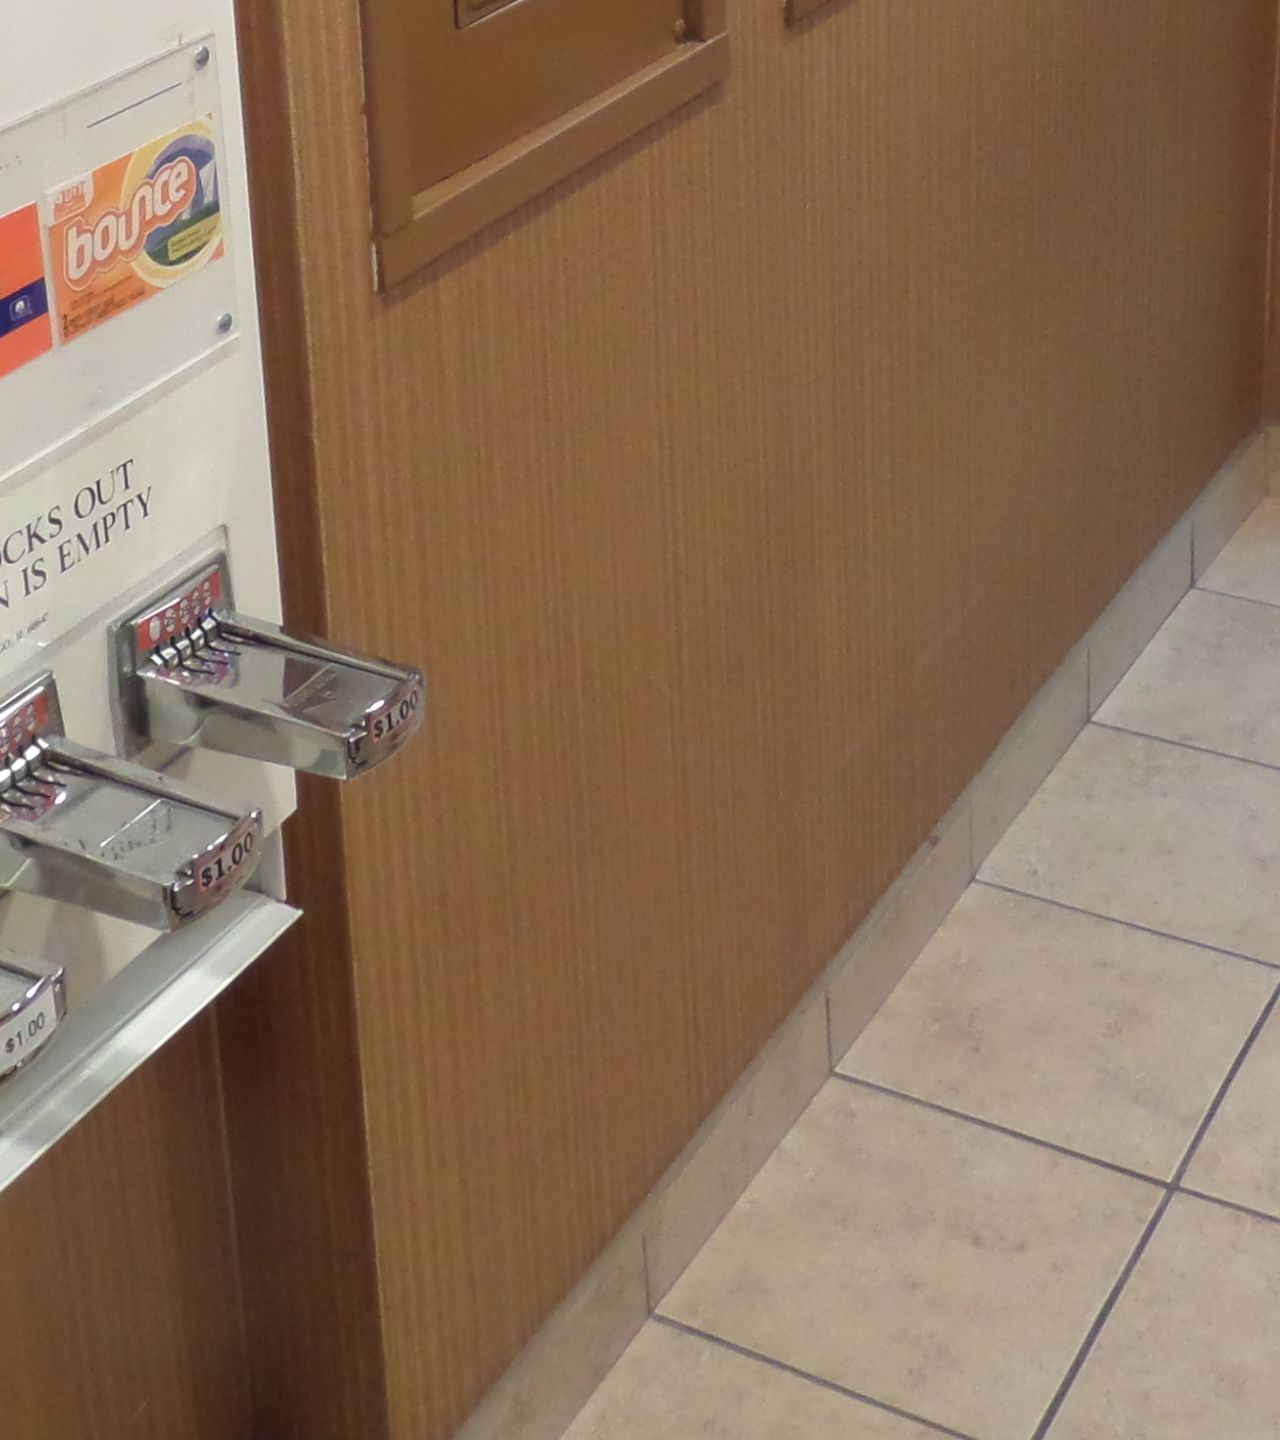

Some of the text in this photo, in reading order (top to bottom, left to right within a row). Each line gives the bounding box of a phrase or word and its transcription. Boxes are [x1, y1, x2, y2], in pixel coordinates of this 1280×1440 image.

[66, 161, 189, 281] bounce
[73, 459, 134, 520] OUT
[21, 557, 48, 597] IS
[59, 486, 152, 575] EMPTY
[375, 690, 417, 738] $1.00
[201, 832, 253, 887] $1.00
[5, 1011, 45, 1054] $1.00
